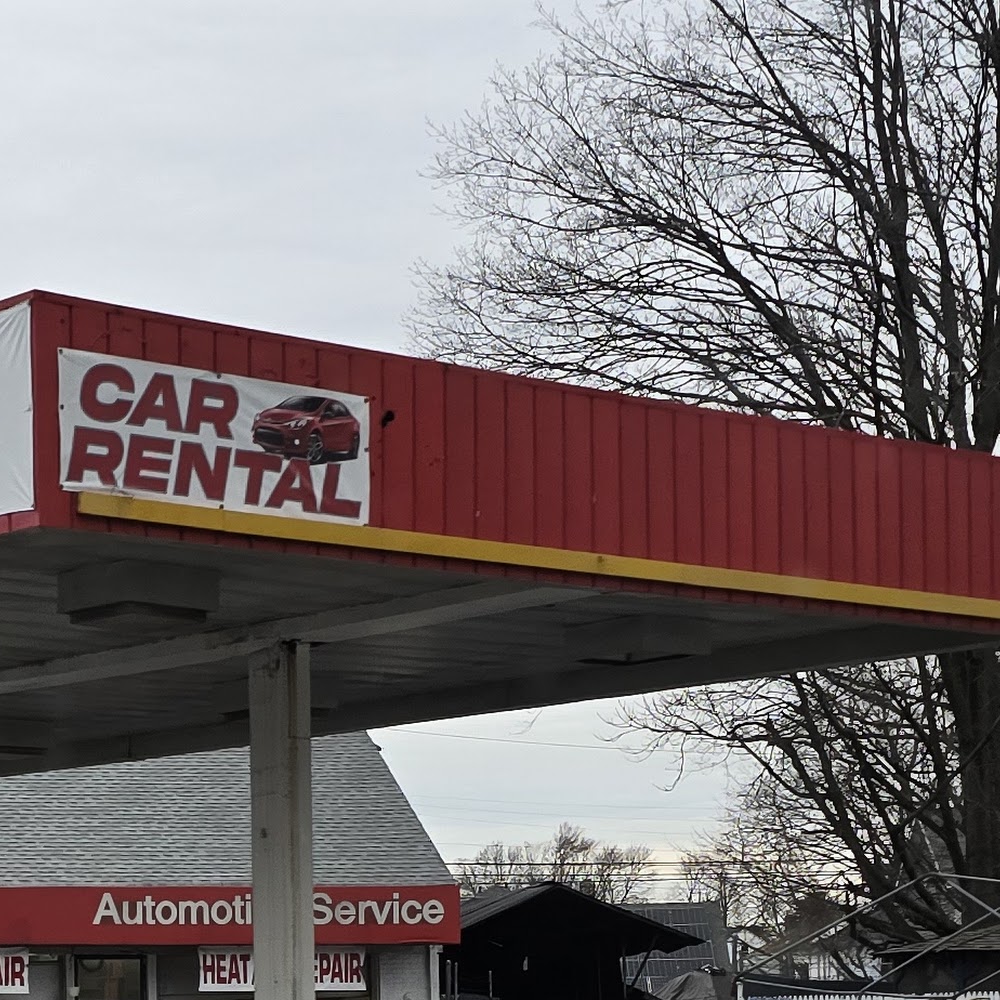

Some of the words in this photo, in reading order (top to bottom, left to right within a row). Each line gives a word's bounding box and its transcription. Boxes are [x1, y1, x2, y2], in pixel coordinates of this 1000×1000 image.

[79, 363, 240, 440] CAR
[65, 424, 361, 518] RENTAL
[313, 892, 445, 926] Service
